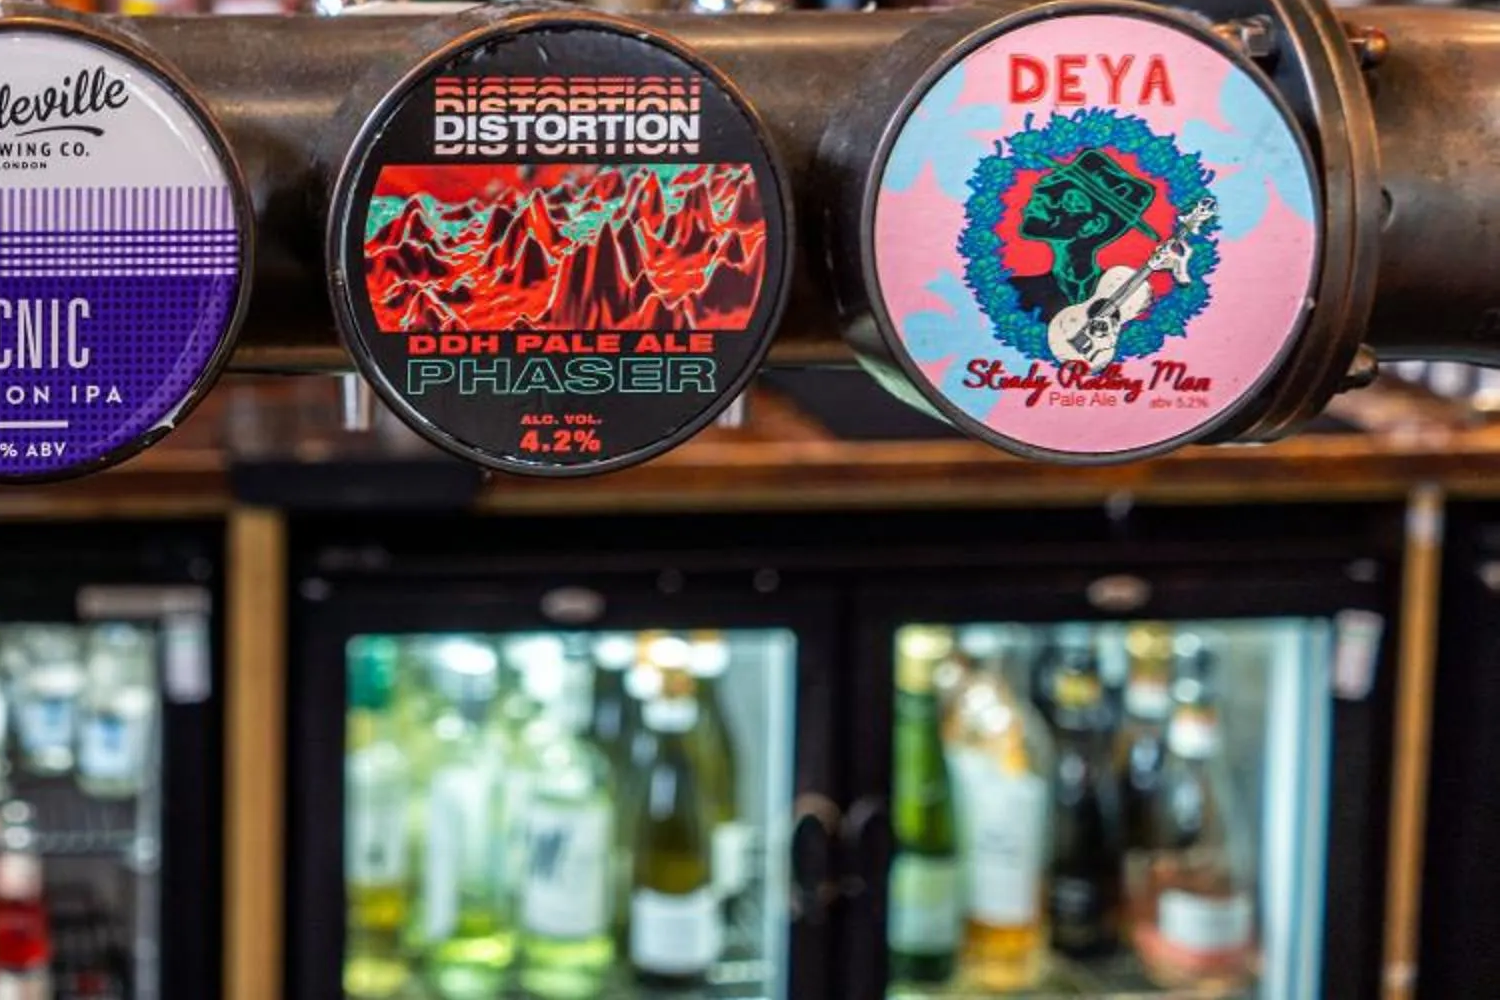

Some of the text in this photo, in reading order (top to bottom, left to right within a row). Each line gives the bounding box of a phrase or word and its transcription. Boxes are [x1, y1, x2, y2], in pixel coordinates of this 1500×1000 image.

[1008, 53, 1175, 107] DEYA
[434, 114, 700, 141] DISTORTION
[60, 142, 90, 157] CO.
[408, 333, 715, 354] DDH PALE ALE
[407, 357, 717, 395] PHASER
[71, 385, 122, 404] IPA
[1050, 392, 1085, 407] Pale
[1090, 392, 1117, 407] Ale
[520, 414, 559, 425] ALC.
[26, 441, 66, 457] ABV
[519, 430, 601, 453] 4.2%
